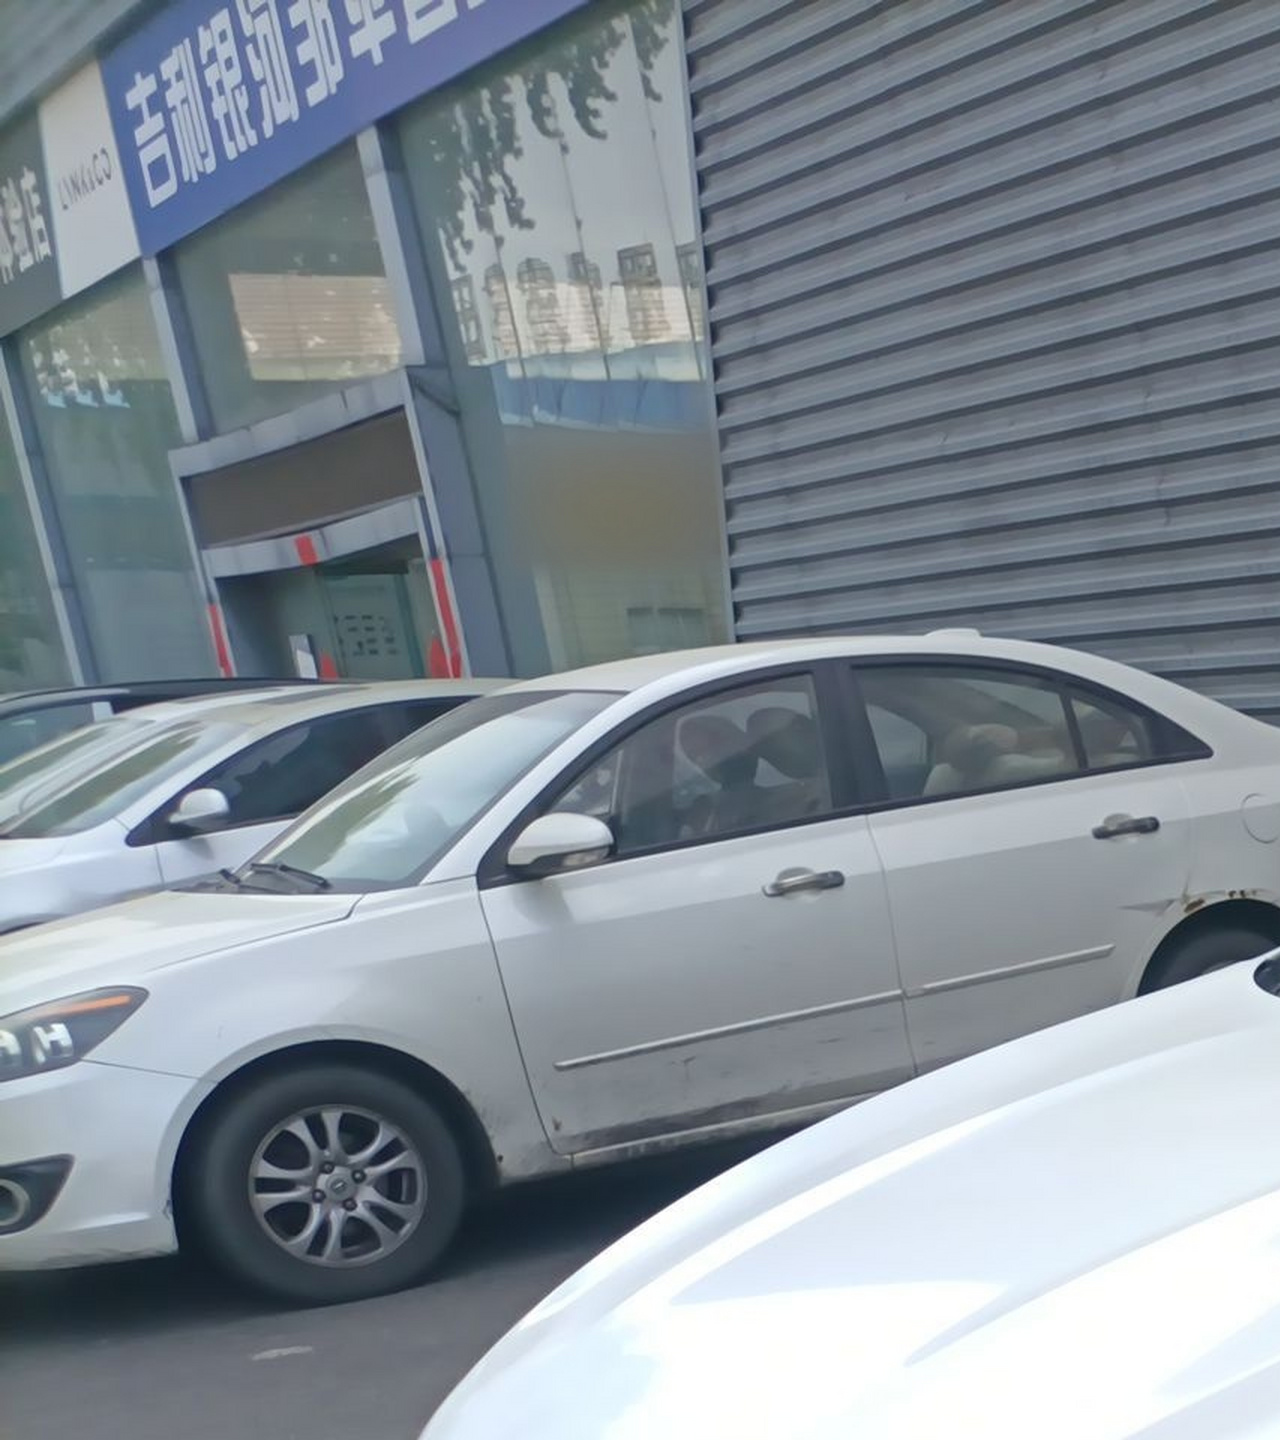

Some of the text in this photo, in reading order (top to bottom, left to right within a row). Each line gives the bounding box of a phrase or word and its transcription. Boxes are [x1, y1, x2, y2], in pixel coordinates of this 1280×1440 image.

[126, 0, 489, 208] 吉利银河邹平
